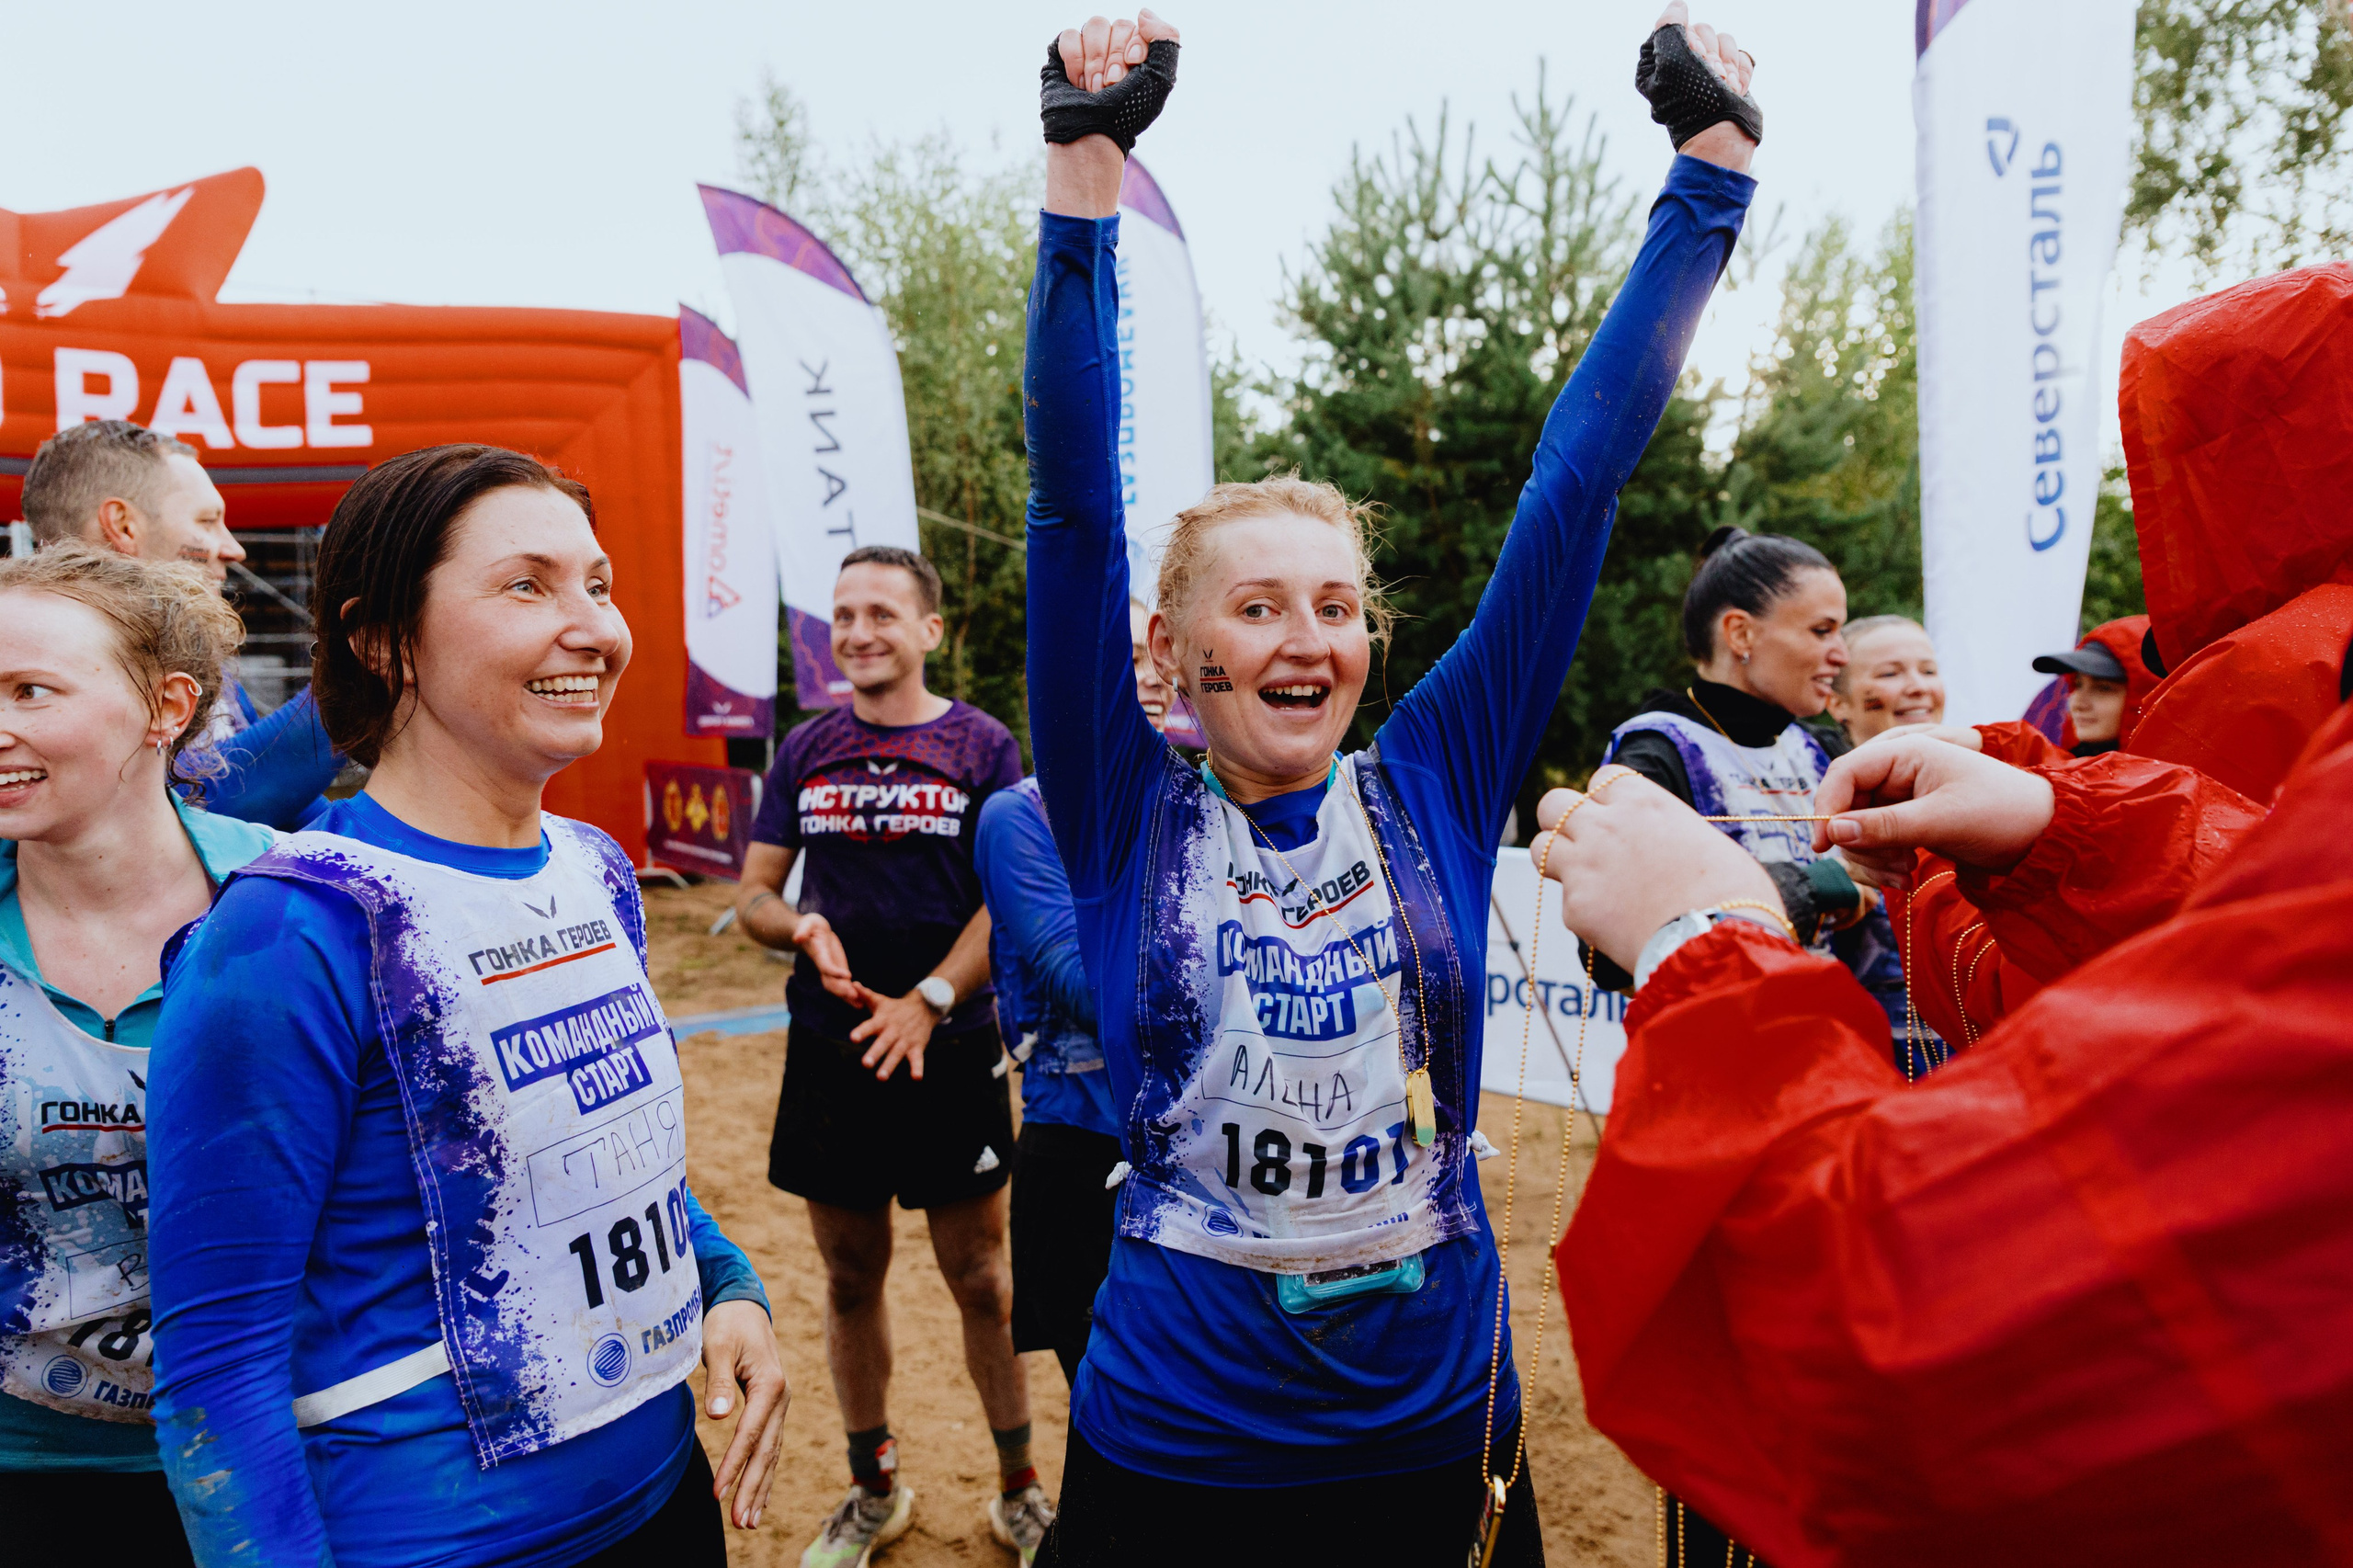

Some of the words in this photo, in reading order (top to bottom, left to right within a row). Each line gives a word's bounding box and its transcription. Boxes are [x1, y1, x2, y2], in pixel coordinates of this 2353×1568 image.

[2028, 142, 2080, 552] Северсталь
[53, 346, 374, 449] RACE
[1199, 665, 1226, 676] ГОНКА
[1200, 681, 1233, 693] ГЕРОЕВ
[800, 814, 867, 835] ГОНКА
[874, 814, 961, 837] ГЕРОЕВ
[468, 935, 558, 976] ГОНКА
[556, 919, 612, 951] ГЕРОЕВ
[1222, 919, 1399, 993] КОМАНДНЫЙ
[498, 983, 655, 1081] КОМАНДНЫЙ
[1252, 992, 1346, 1036] СТАРТ
[571, 1046, 644, 1107] СТАРТ
[41, 1101, 142, 1125] ГОНКА
[562, 1100, 680, 1188] ТАНЯ
[1222, 1122, 1409, 1199] 18101
